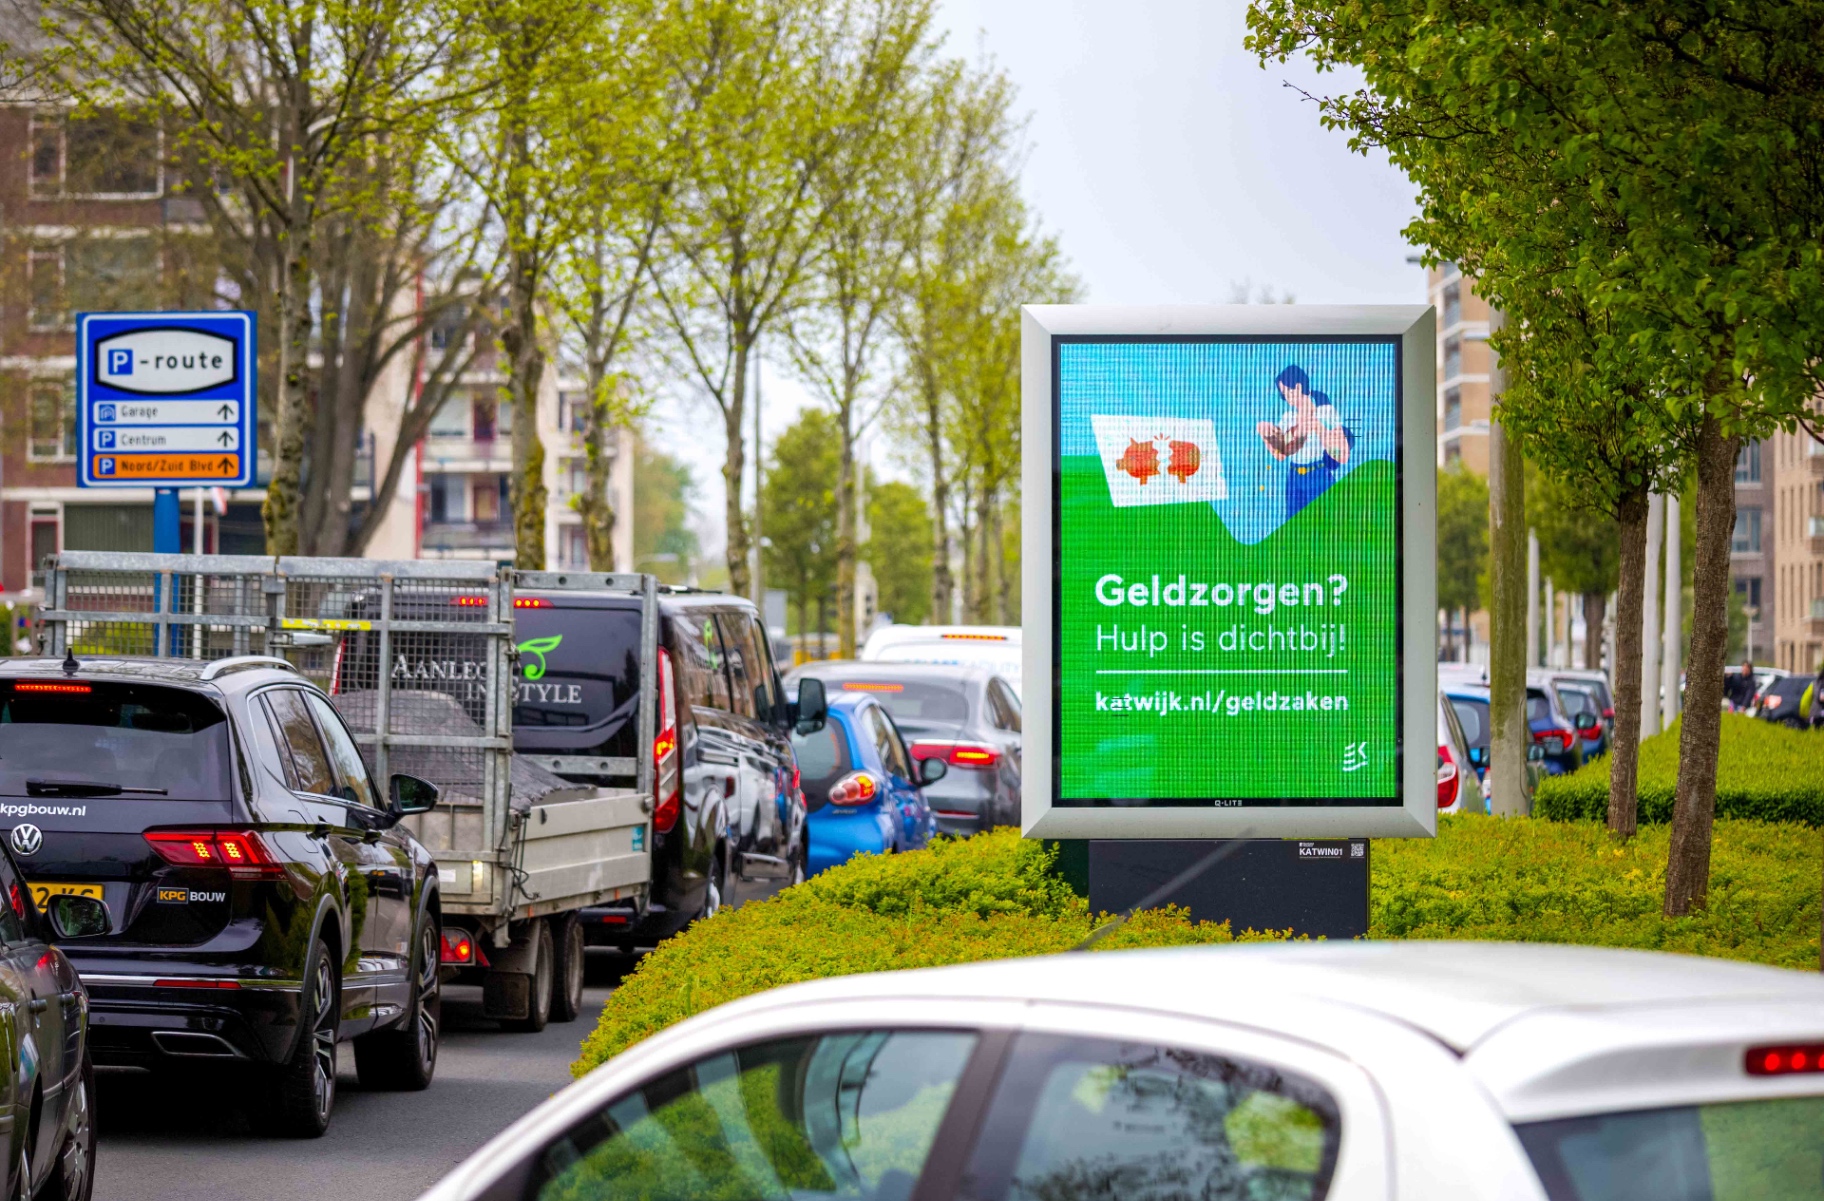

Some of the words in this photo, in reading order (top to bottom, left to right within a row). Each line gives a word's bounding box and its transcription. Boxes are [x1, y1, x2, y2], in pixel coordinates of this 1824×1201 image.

[121, 405, 159, 418] Garage
[121, 434, 167, 446] Centrum
[121, 460, 184, 472] Noord/Zuid
[190, 460, 213, 472] Blvd
[1095, 573, 1348, 614] Geldzorgen?
[1096, 623, 1168, 658] Hulp
[1181, 623, 1205, 651] is
[1218, 623, 1346, 658] dichtbij!
[1095, 690, 1349, 717] katwijk.nl/geldzaken
[0, 803, 86, 817] kpgbouw.nl
[1299, 848, 1343, 856] KATWIN01
[159, 890, 186, 901] KPG
[190, 891, 225, 902] BOUW
